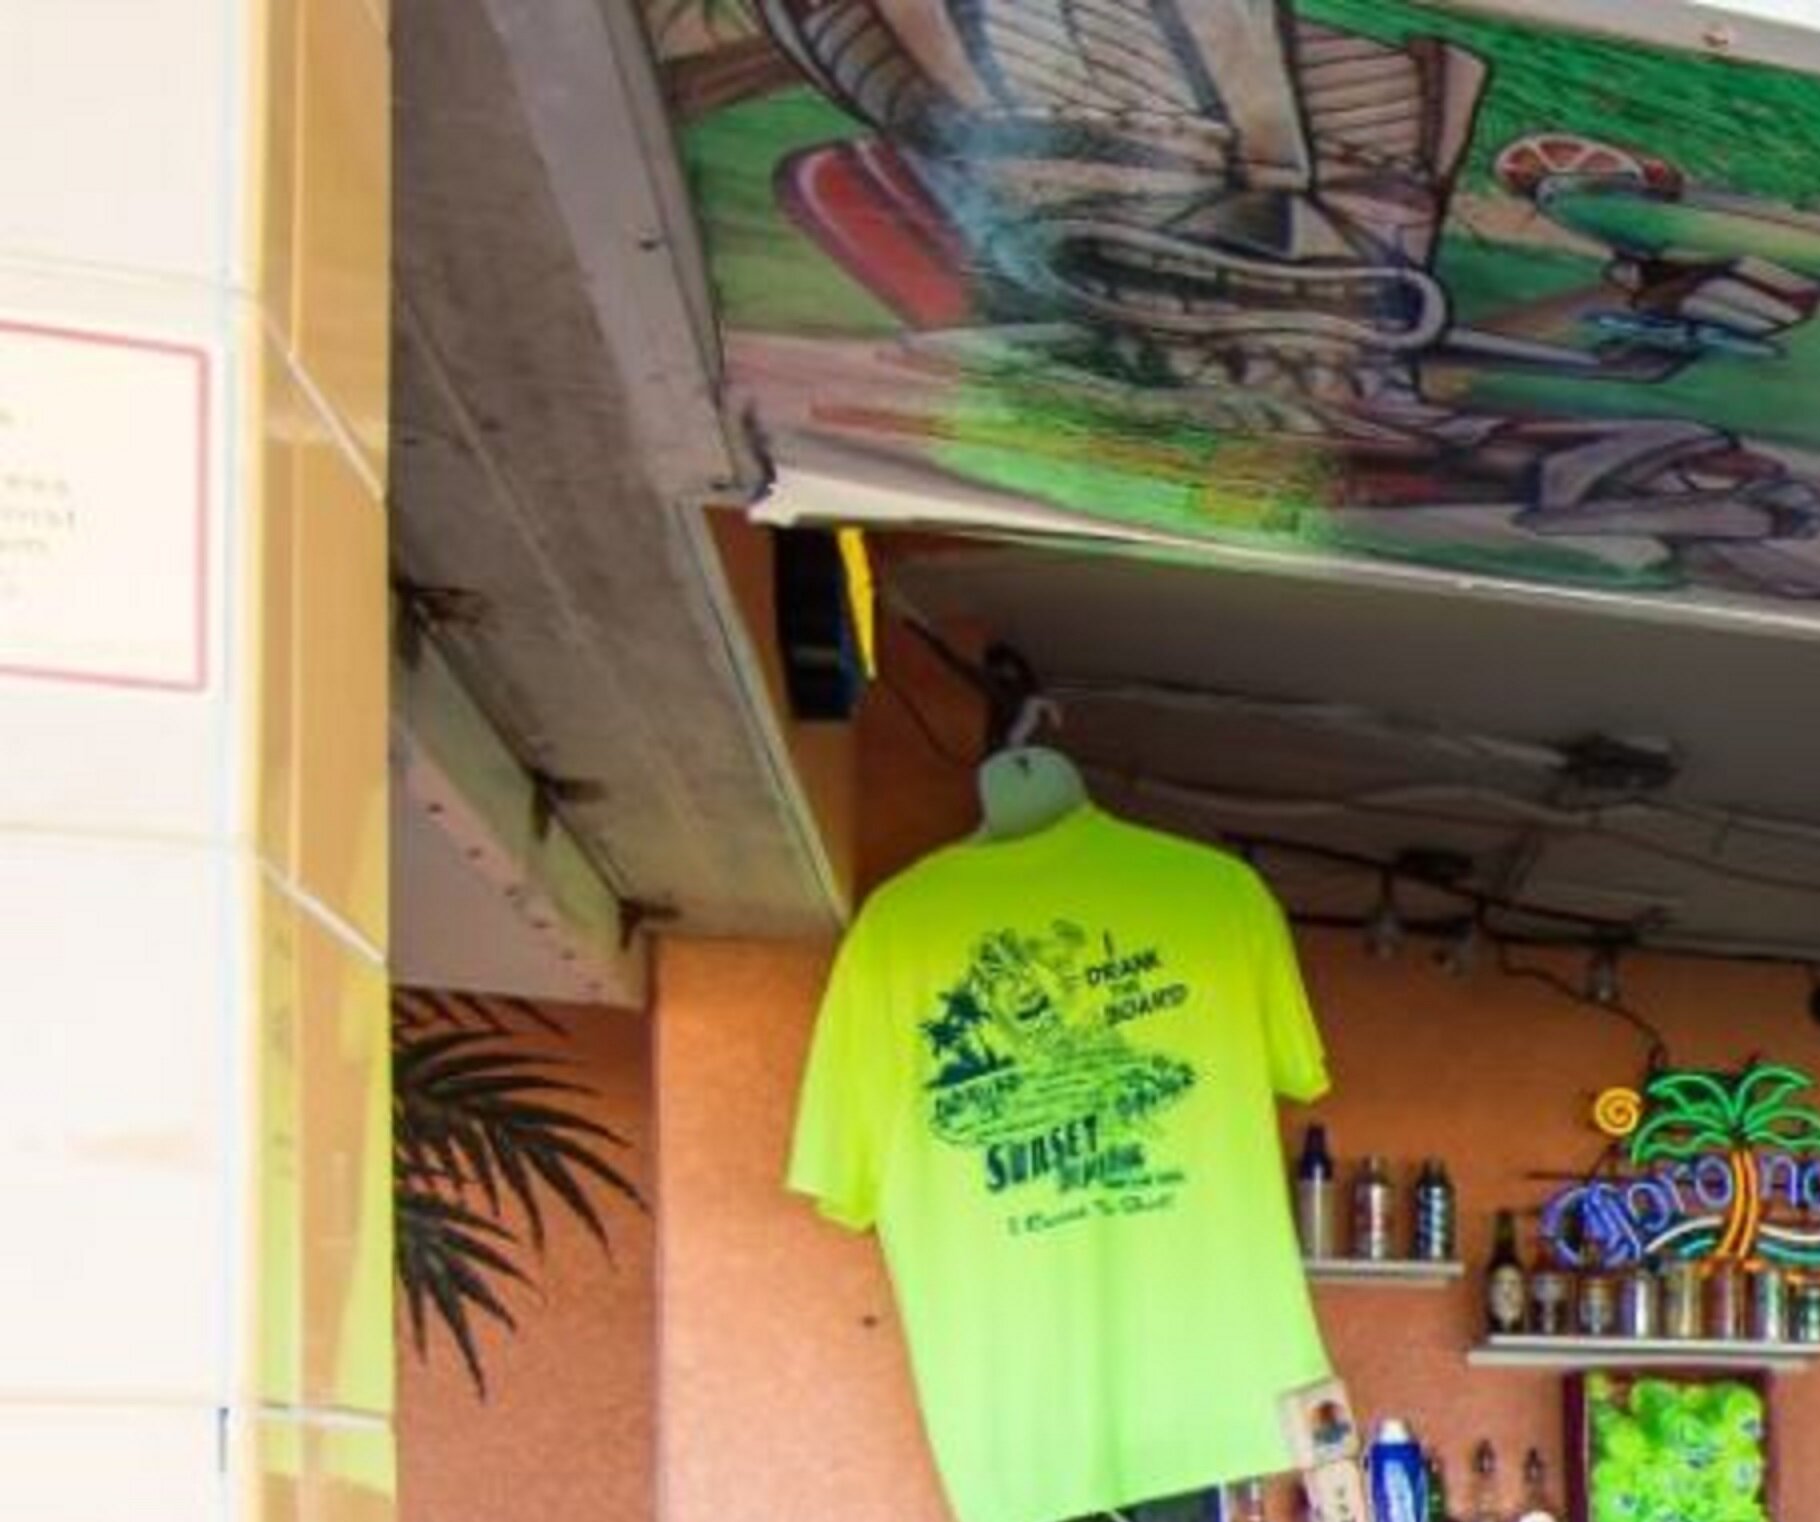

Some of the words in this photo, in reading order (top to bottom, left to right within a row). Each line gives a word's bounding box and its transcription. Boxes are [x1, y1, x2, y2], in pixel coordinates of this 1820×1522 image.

[1085, 949, 1161, 988] DRANK
[1104, 981, 1190, 1026] BOARD
[985, 1113, 1098, 1193] SUNSET
